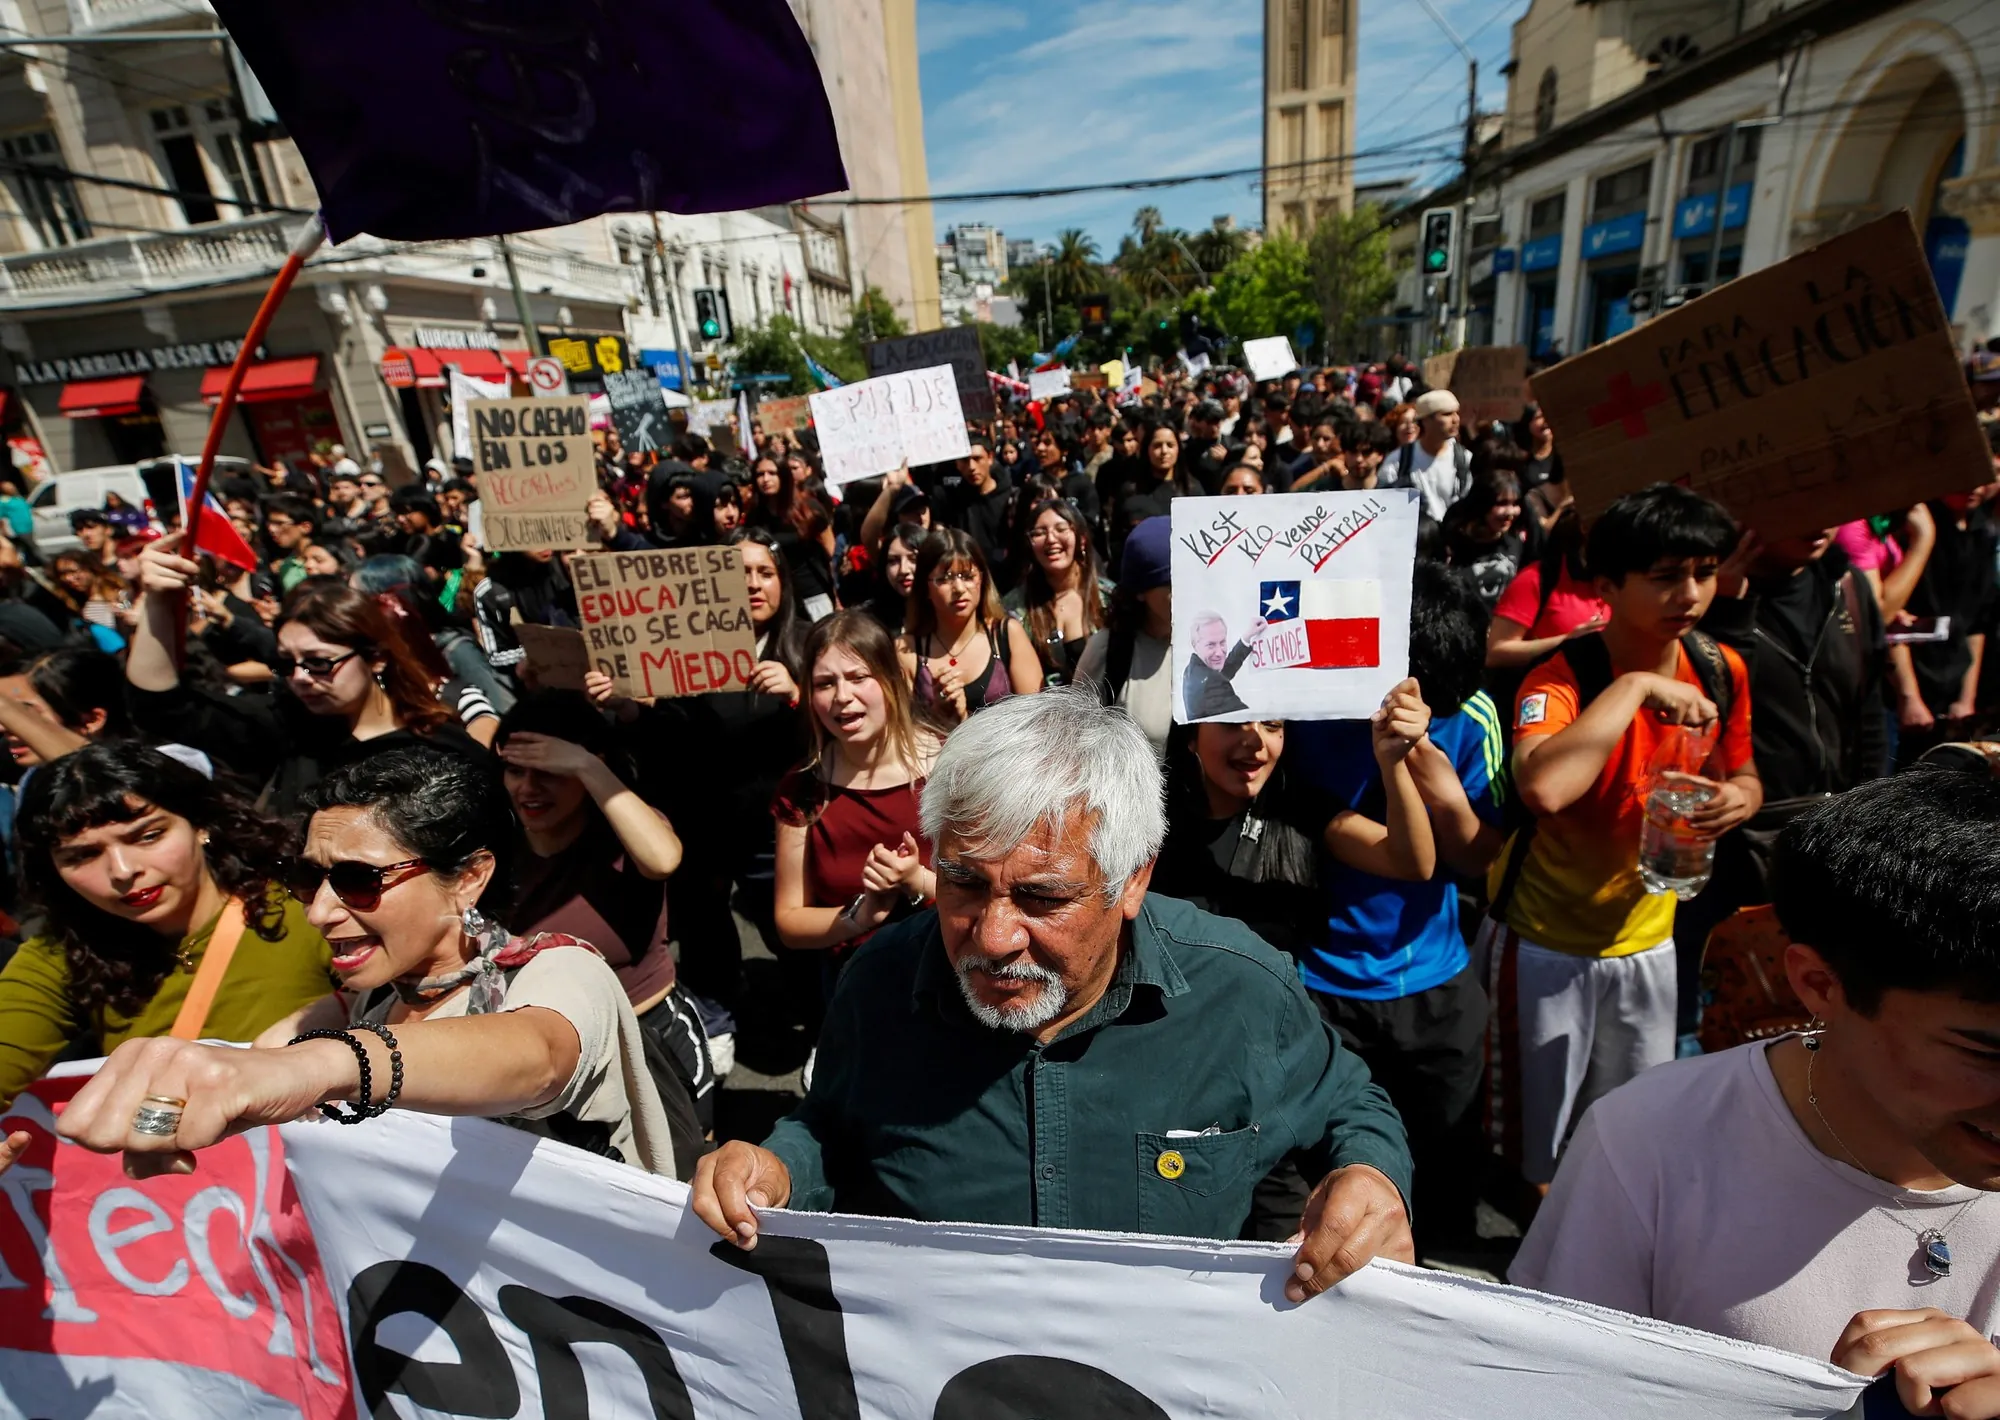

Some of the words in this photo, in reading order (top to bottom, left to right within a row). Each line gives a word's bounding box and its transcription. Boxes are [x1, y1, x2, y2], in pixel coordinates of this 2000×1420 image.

[1660, 314, 1754, 368] PARA
[1806, 266, 1871, 304] LA
[474, 407, 516, 438] NO
[518, 406, 586, 437] CAEMO
[480, 440, 512, 472] EN
[1701, 432, 1775, 472] PARA
[573, 558, 610, 591] EL
[616, 552, 700, 582] POBRE
[706, 550, 736, 574] SE
[581, 584, 677, 624] EDUCA
[588, 624, 637, 650] RICO
[646, 614, 681, 645] SE
[687, 607, 753, 636] CAGA
[1251, 639, 1267, 668] SE
[1267, 627, 1305, 664] VENDE
[595, 654, 631, 680] DE
